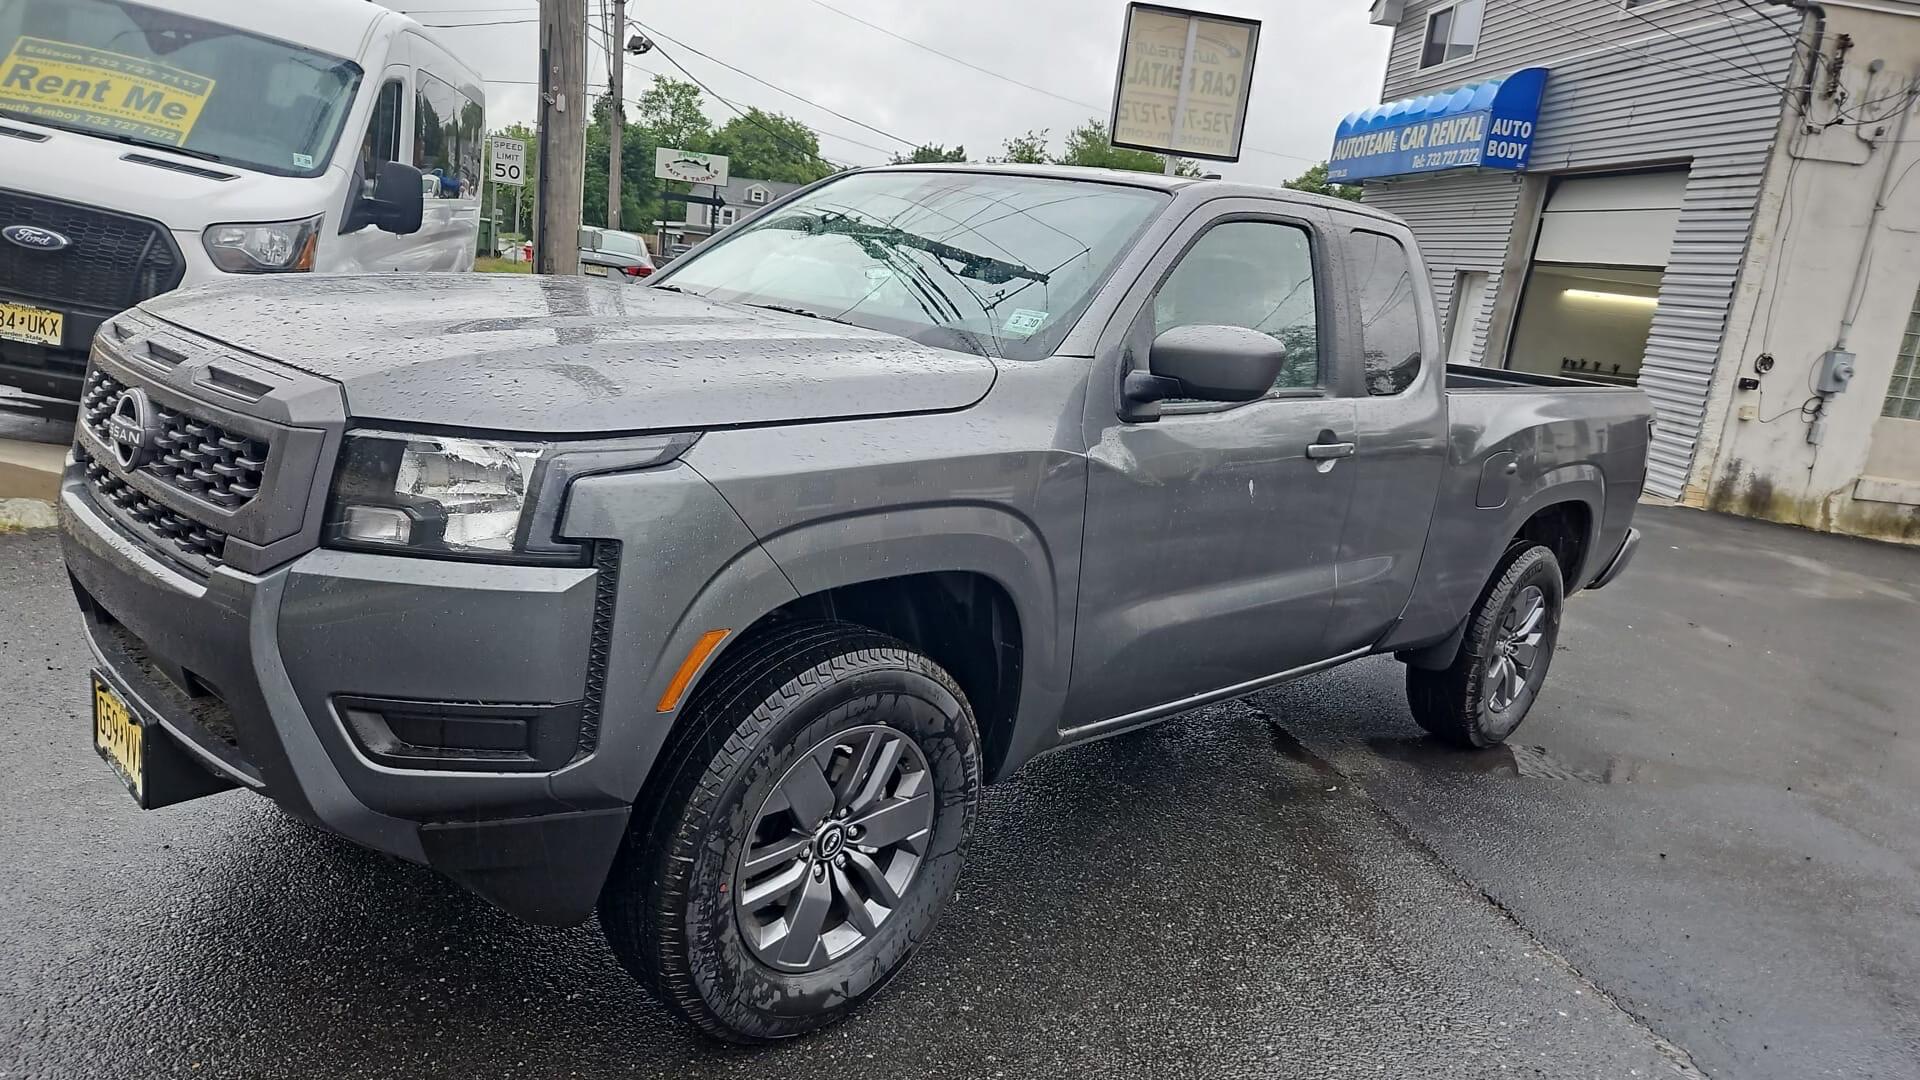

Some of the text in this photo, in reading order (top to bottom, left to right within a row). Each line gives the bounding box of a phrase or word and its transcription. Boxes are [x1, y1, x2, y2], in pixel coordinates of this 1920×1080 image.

[2, 63, 188, 120] Rent Me
[0, 102, 177, 141] outh Amboy 732 727 7272
[1491, 118, 1532, 139] AUTO
[494, 141, 523, 151] SPEED
[1331, 130, 1395, 161] AUTOTEAM
[1400, 124, 1428, 151] CAR
[1428, 115, 1484, 148] RENTAL
[496, 151, 520, 161] LIMIT
[1426, 152, 1441, 167] 732
[1486, 140, 1528, 160] BODY
[495, 162, 520, 180] 50
[664, 163, 680, 176] BAIT
[690, 169, 719, 182] TACKLE
[14, 228, 51, 246] Ford
